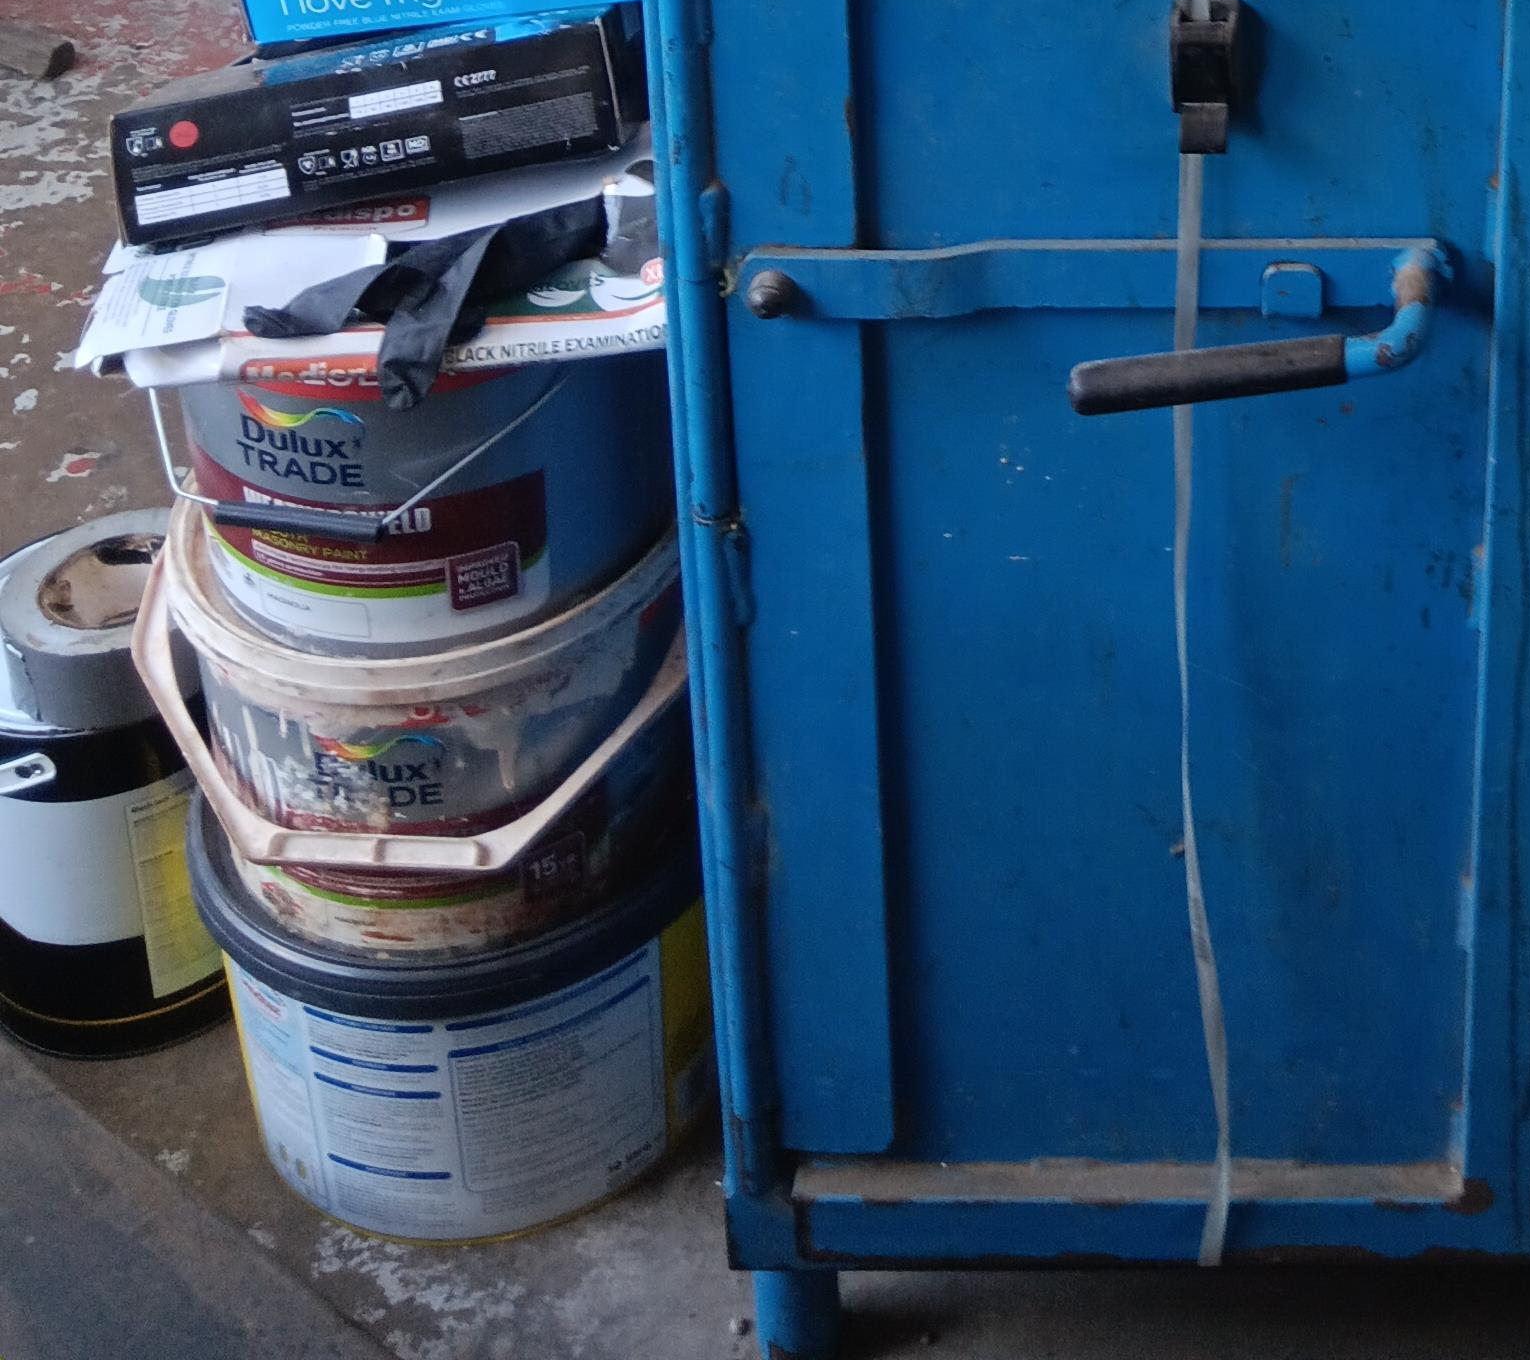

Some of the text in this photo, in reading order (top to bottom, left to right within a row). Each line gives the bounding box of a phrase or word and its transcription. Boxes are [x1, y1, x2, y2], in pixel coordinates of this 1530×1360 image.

[443, 345, 496, 365] BLACK
[500, 340, 562, 359] NITRILE
[240, 413, 352, 460] Dulux
[236, 439, 366, 488] TRADE
[322, 546, 369, 561] PAINT
[457, 561, 509, 584] MOULD
